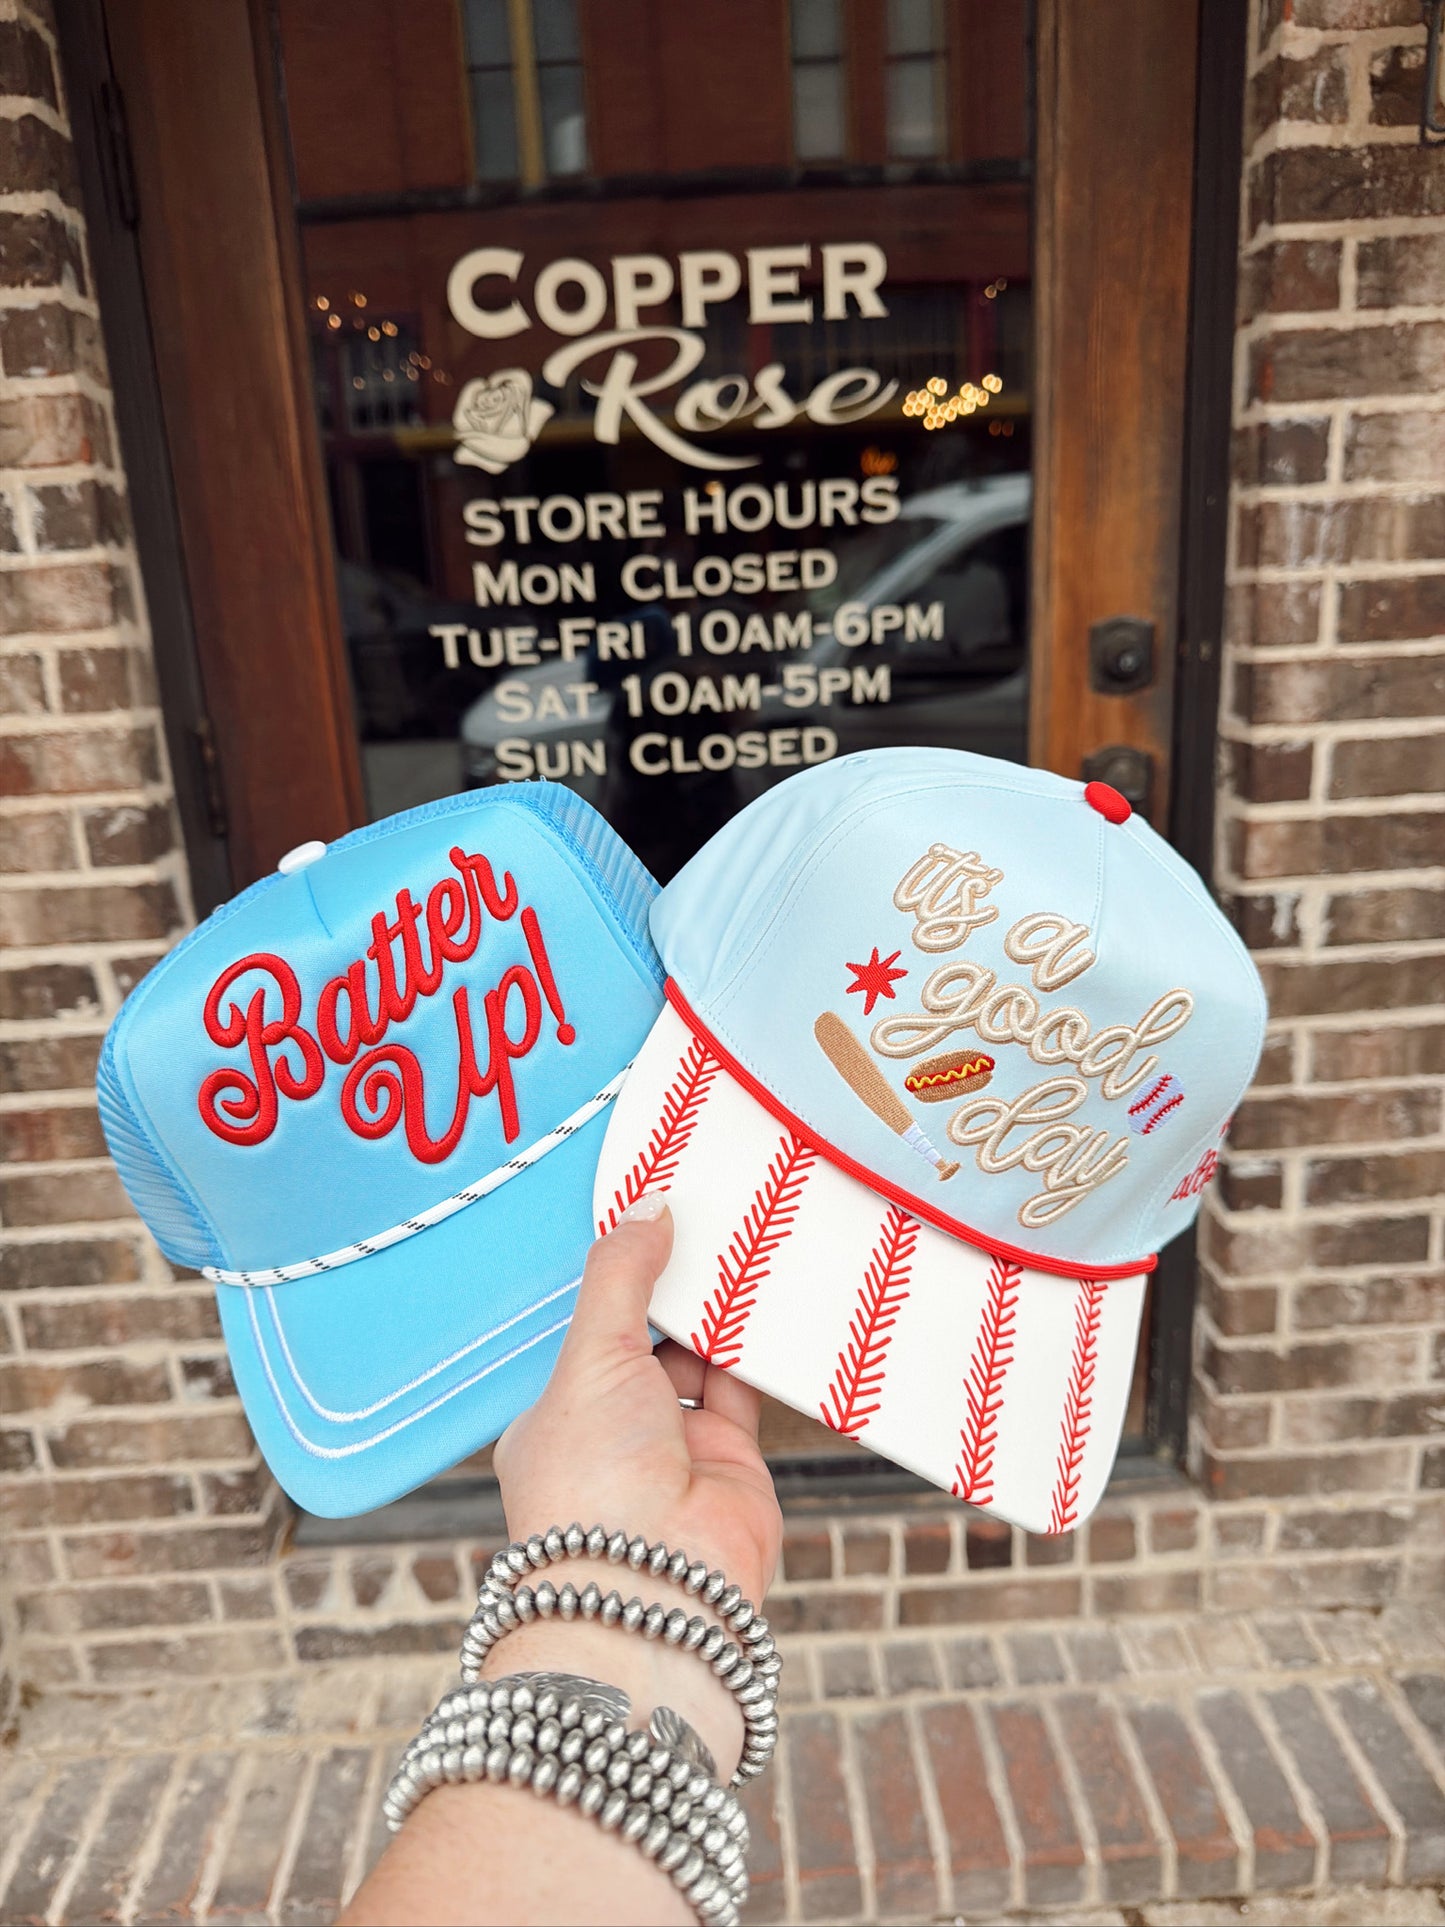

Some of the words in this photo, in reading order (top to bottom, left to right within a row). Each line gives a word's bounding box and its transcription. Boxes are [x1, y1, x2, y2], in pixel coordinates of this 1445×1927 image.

[447, 244, 889, 339] COPPER
[542, 326, 900, 471] Rose
[463, 490, 666, 547] STORE
[684, 476, 902, 535] HOURS
[672, 601, 945, 657] 10AM-6PM
[621, 664, 892, 718] 10AM-5PM
[198, 846, 519, 1147] Batter
[1004, 912, 1096, 993] a
[341, 905, 577, 1164] Up!
[870, 960, 1194, 1102] good
[947, 1076, 1130, 1228] day
